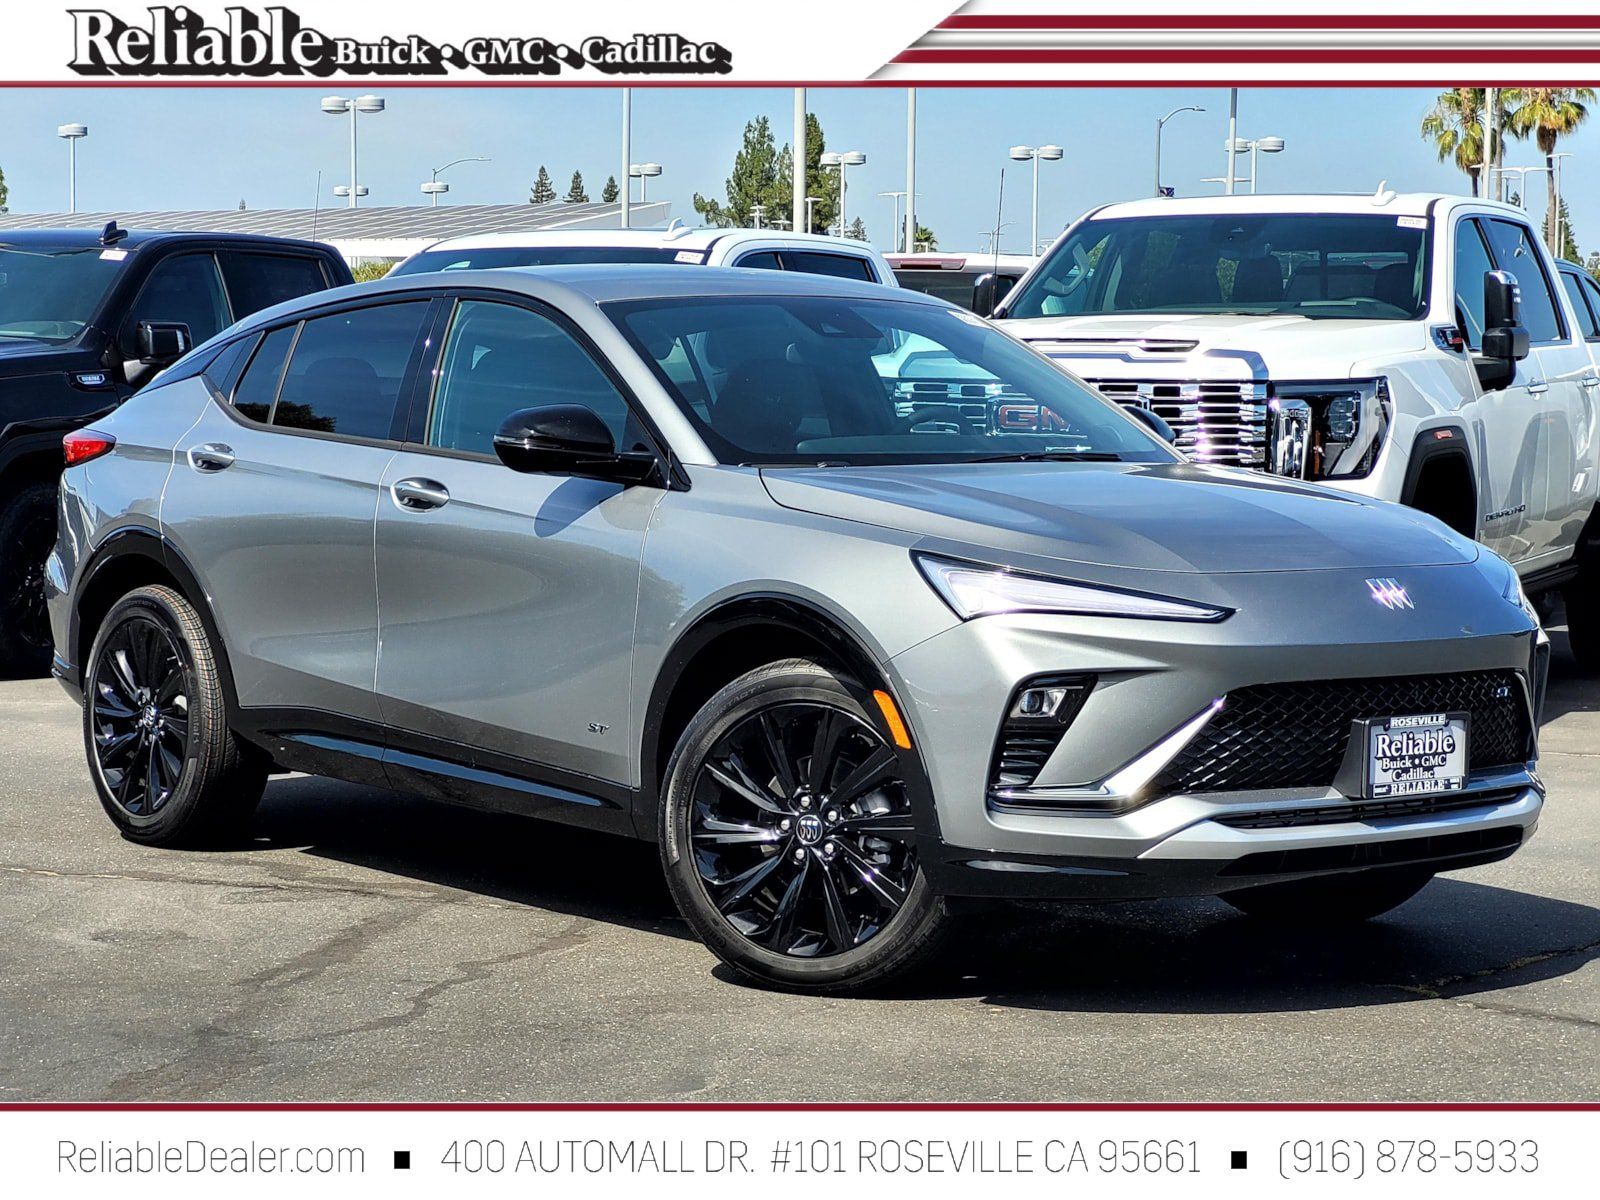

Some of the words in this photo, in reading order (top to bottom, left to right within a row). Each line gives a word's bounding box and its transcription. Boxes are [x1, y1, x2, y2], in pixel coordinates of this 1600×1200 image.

[587, 722, 610, 735] ST
[1391, 715, 1445, 728] ROSEVILLE
[1375, 729, 1455, 758] Reliable
[1381, 757, 1413, 771] Buick
[1421, 754, 1447, 767] GMC
[1391, 769, 1435, 782] Cadillac
[1390, 780, 1445, 795] RELIABLE
